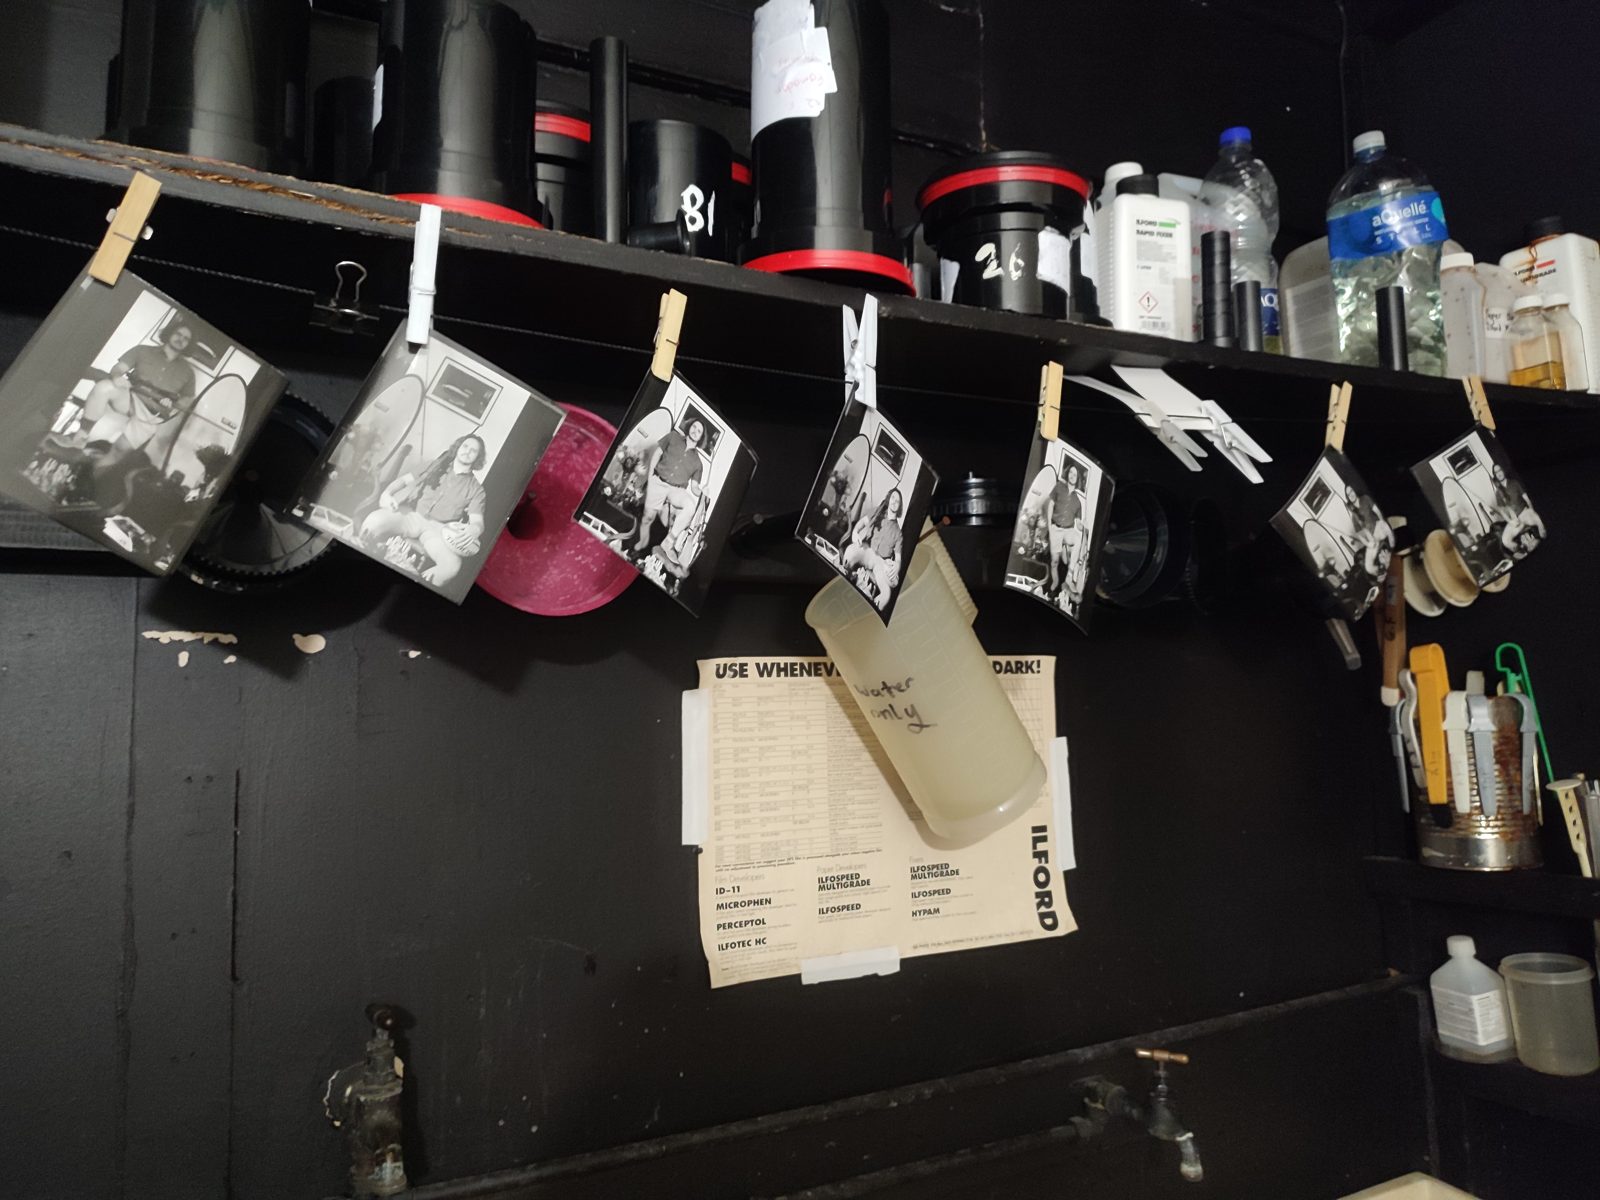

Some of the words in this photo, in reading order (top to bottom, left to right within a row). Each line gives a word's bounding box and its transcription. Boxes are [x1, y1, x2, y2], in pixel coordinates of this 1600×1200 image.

[1135, 229, 1155, 237] RAPID
[975, 243, 1025, 280] 26
[715, 662, 749, 679] USE
[755, 661, 842, 678] WHENEV
[992, 659, 1042, 675] DARK!
[871, 703, 939, 735] only
[910, 863, 951, 874] ILFOSPEED
[910, 869, 960, 881] MULTIGRADE
[817, 872, 861, 885] ILFOSPEED
[1032, 825, 1059, 931] ILFORD
[715, 885, 741, 896] ID-11
[817, 878, 871, 892] MULTIGRADE
[911, 888, 952, 899] ILFOSPEED
[716, 897, 772, 911] MICROPHEN
[818, 903, 862, 915] ILFOSPEED
[911, 907, 941, 918] HYPAM
[716, 917, 767, 931] PERCEPTOL
[717, 939, 752, 952] ILFOTEC
[754, 937, 768, 946] HC
